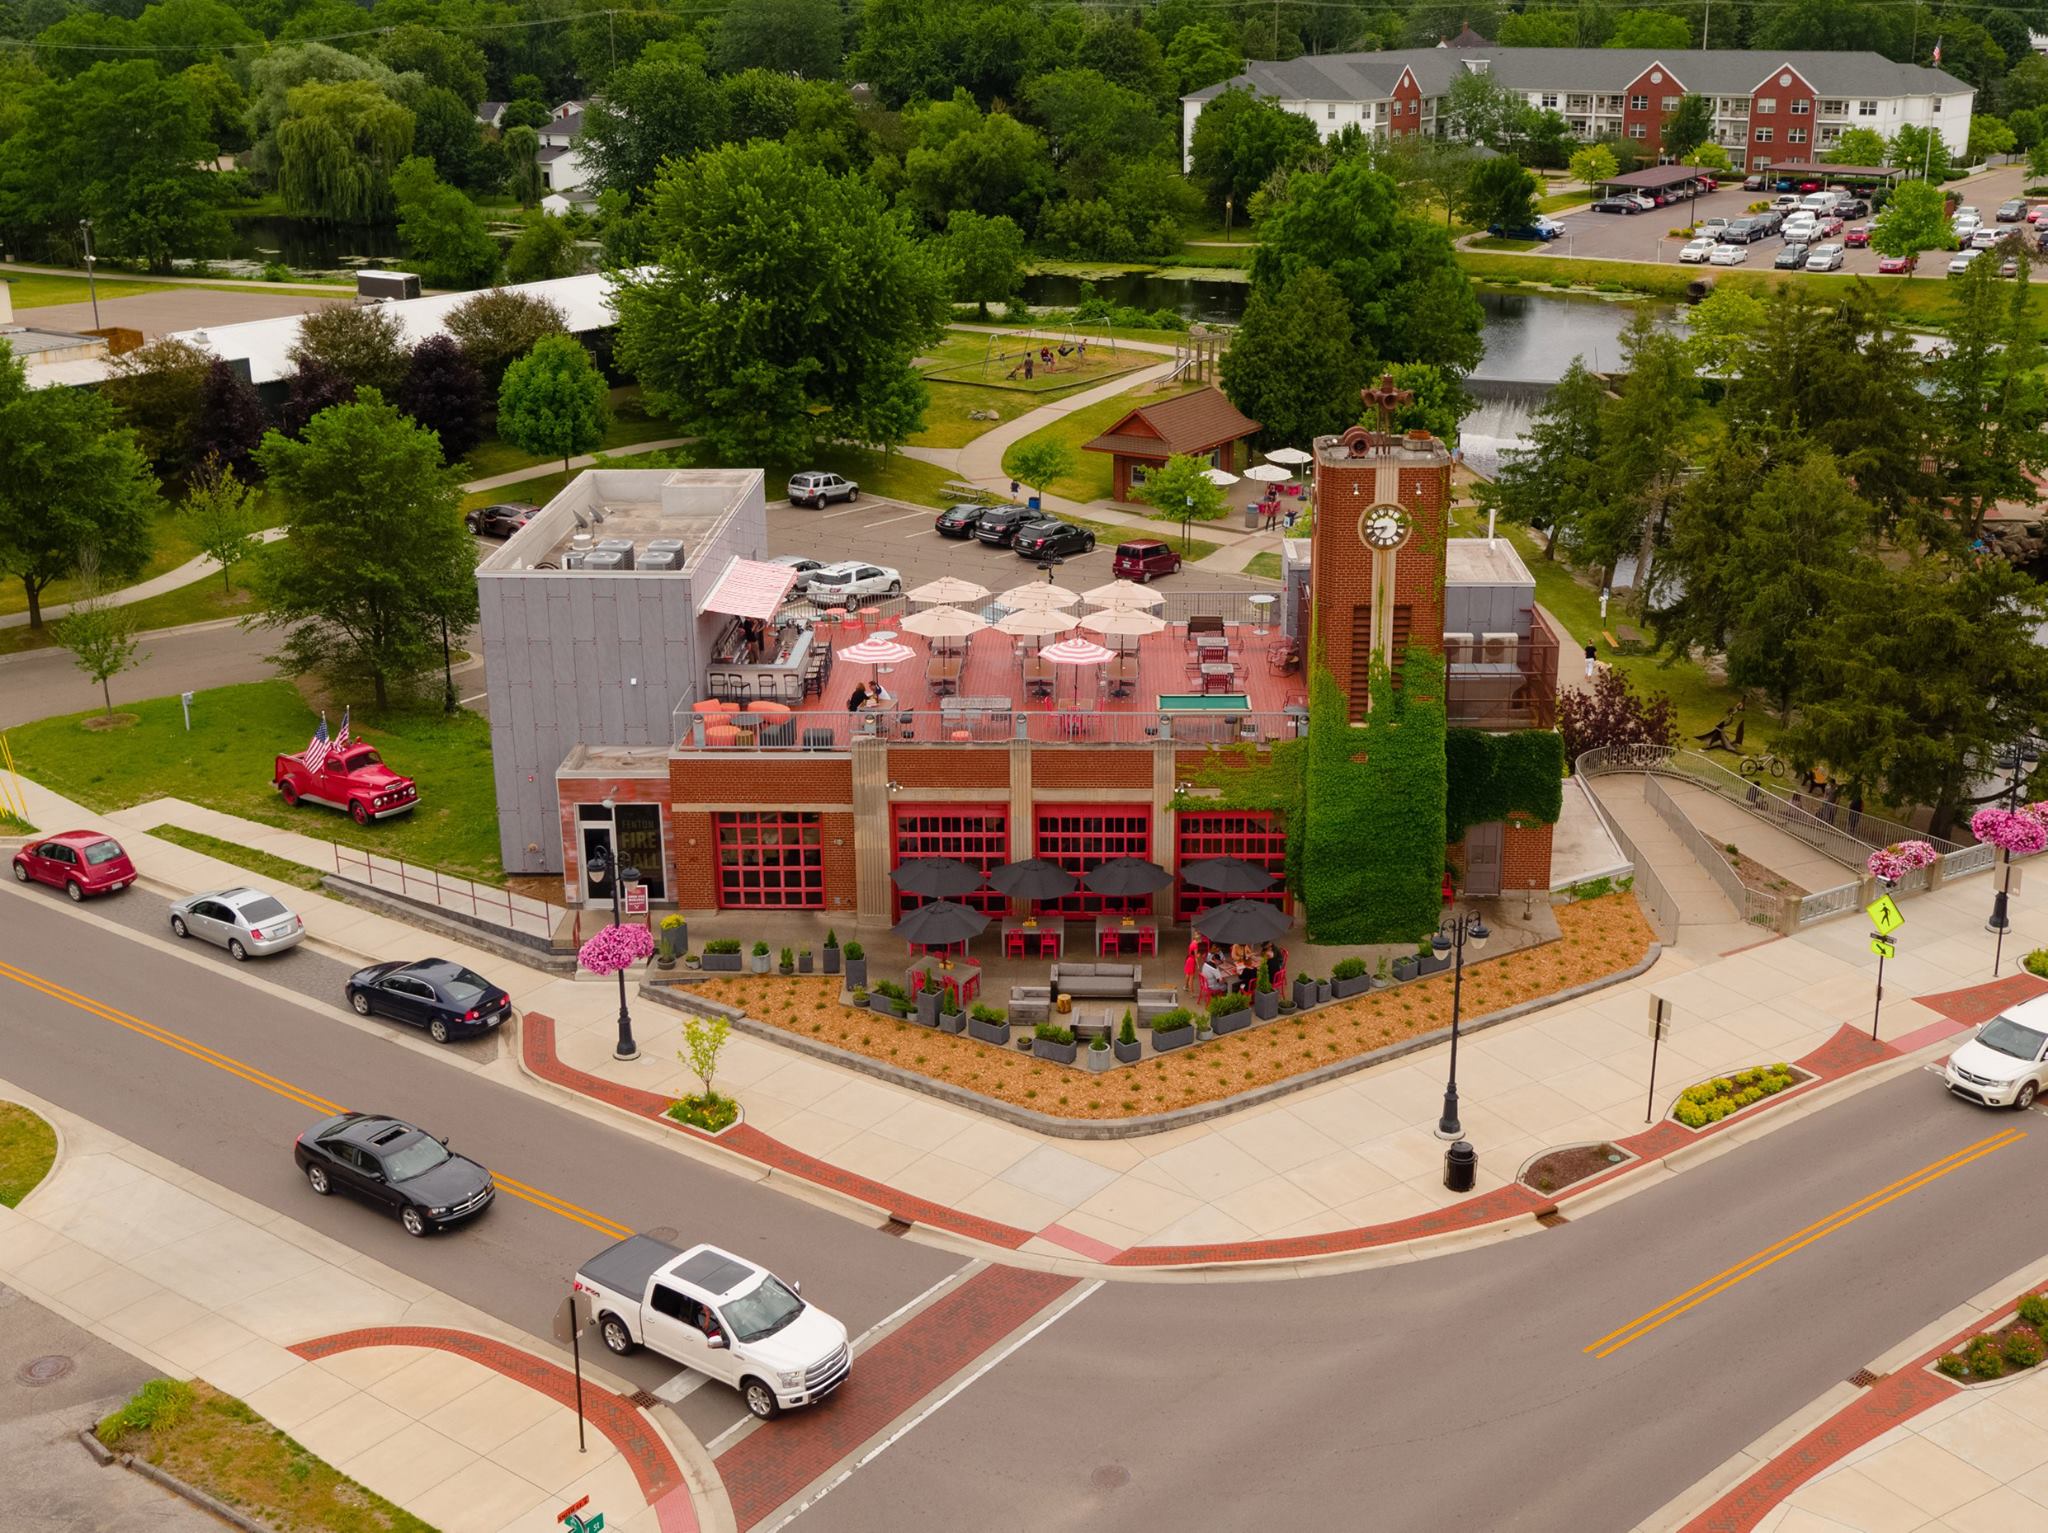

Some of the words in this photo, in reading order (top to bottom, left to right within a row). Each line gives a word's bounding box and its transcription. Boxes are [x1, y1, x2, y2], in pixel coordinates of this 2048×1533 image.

[621, 819, 655, 829] FENTON
[621, 831, 657, 849] FIRE
[624, 852, 661, 870] ALL
